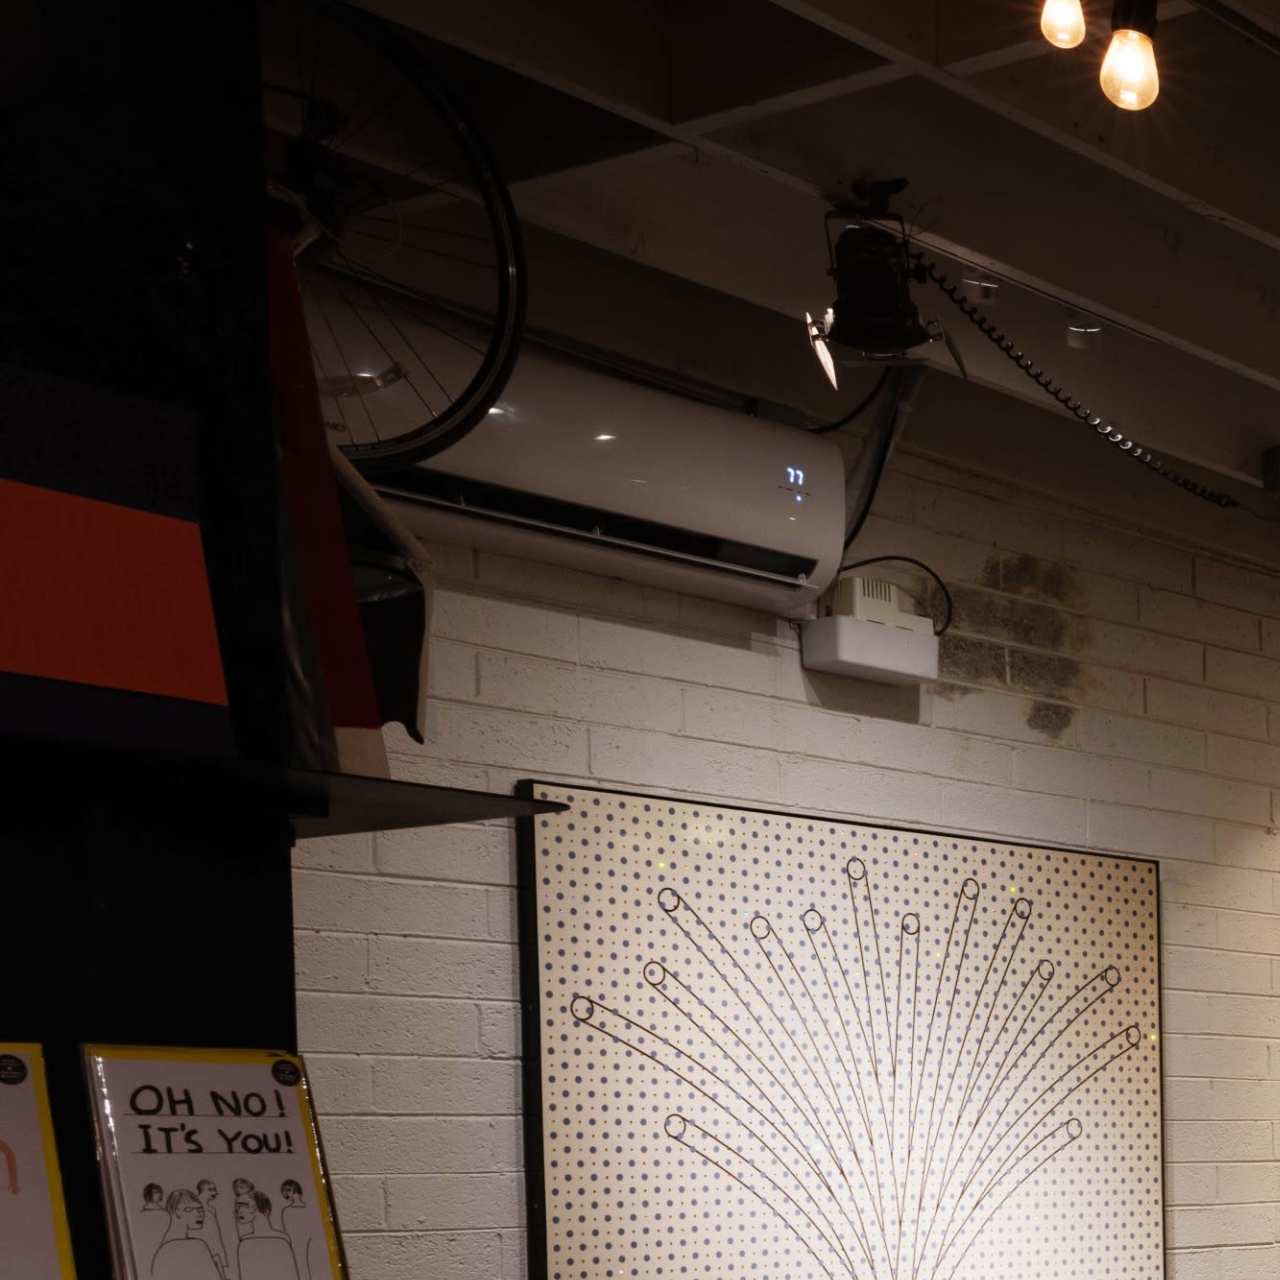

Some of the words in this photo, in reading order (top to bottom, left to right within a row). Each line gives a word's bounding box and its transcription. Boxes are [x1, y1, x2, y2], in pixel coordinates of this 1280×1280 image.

[787, 468, 803, 485] 77
[130, 1085, 194, 1115] OH
[210, 1089, 285, 1117] NO!
[138, 1123, 203, 1153] IT'S
[218, 1129, 293, 1154] YOU!
